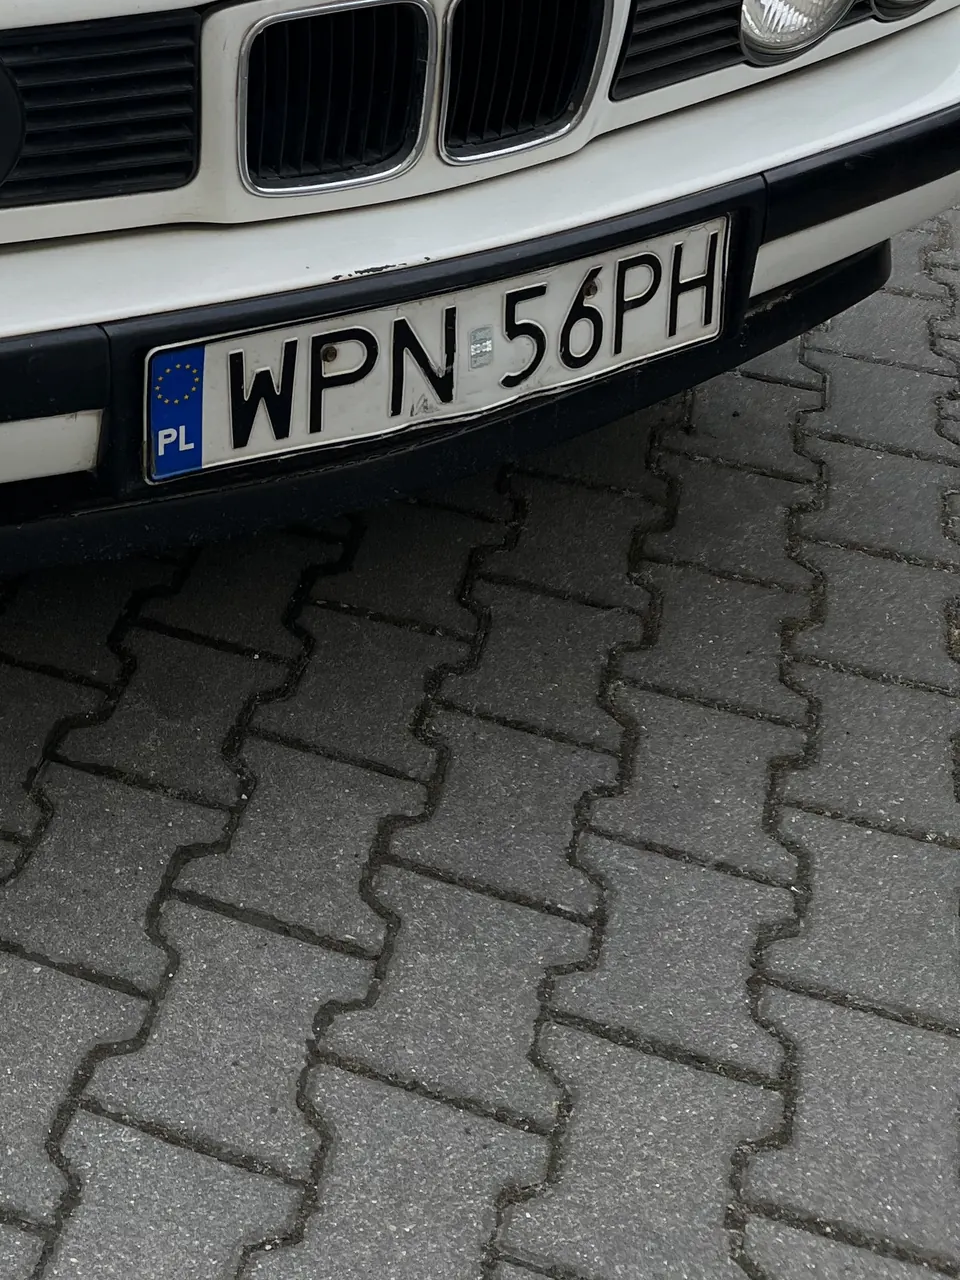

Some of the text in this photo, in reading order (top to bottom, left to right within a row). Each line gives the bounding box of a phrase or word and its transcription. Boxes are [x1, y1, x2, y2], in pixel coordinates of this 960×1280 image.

[228, 231, 720, 450] WPN 56PH
[157, 426, 195, 457] PL
